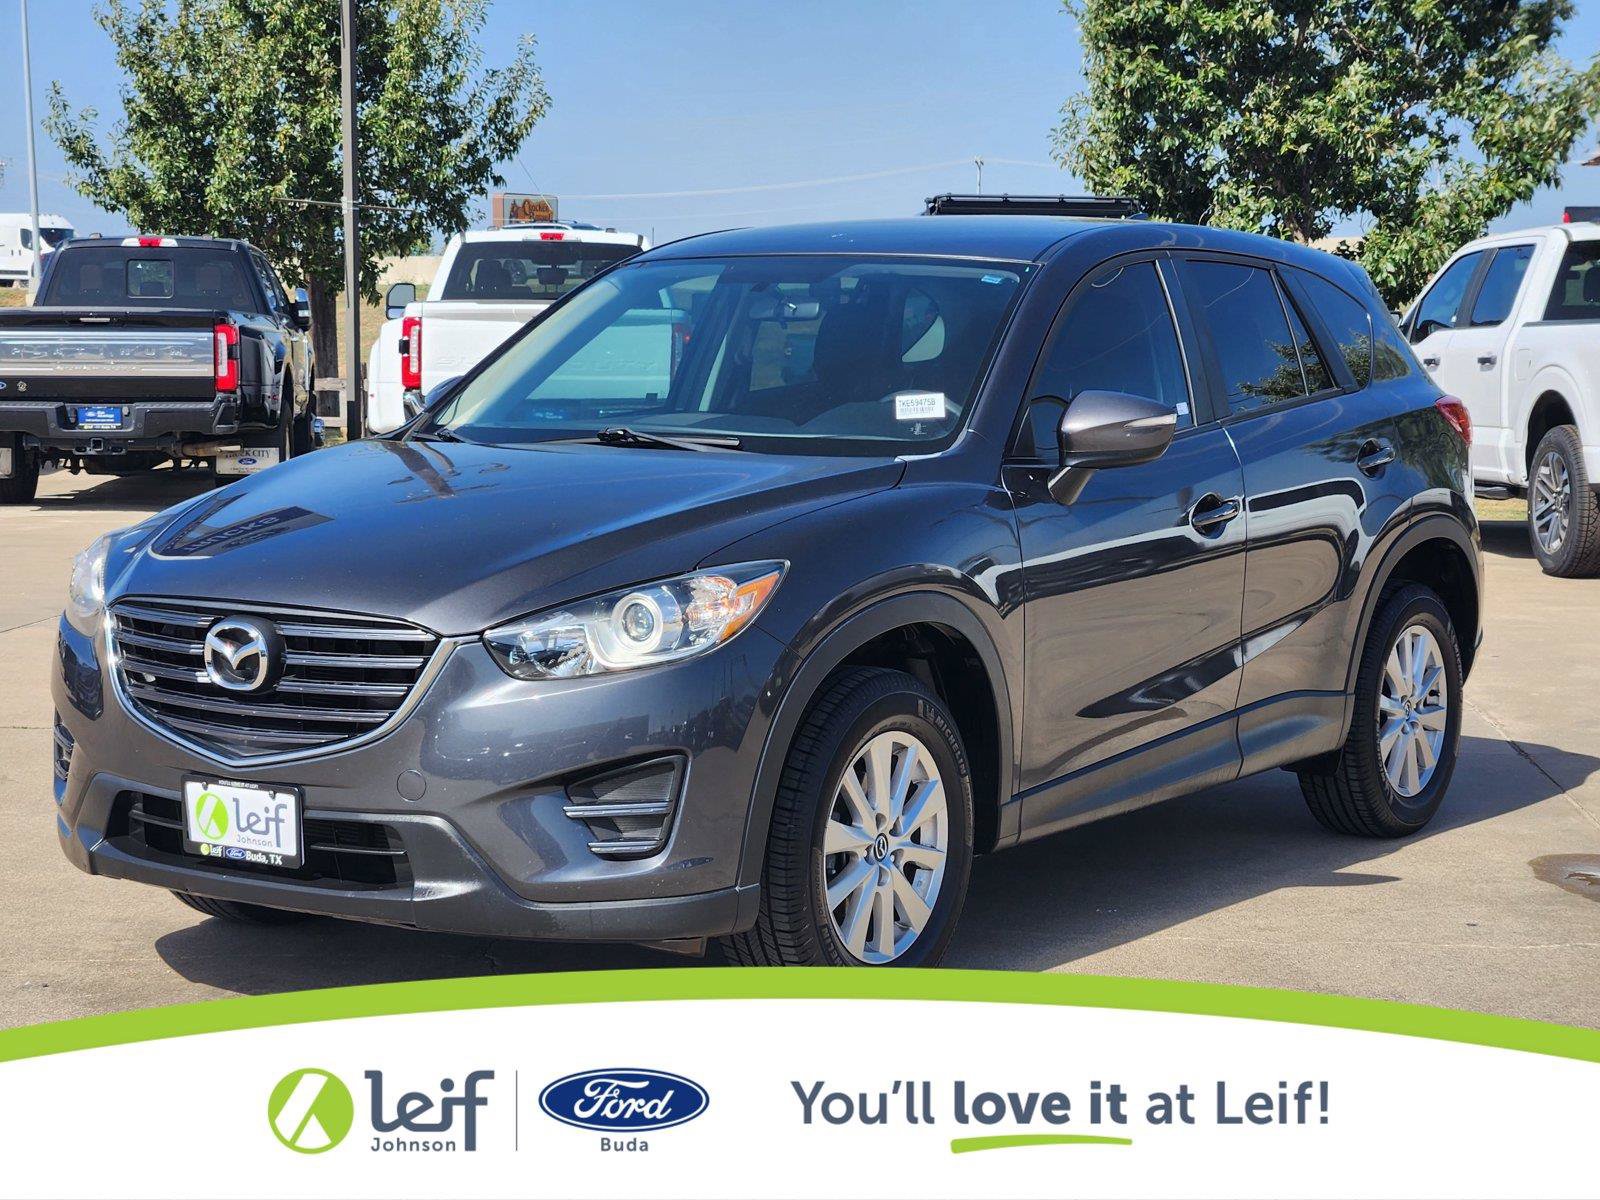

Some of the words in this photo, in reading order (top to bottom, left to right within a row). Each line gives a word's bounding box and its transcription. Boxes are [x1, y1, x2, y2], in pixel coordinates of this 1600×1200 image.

[236, 834, 273, 847] Johnson
[245, 850, 268, 864] Buda,
[269, 854, 283, 866] TX
